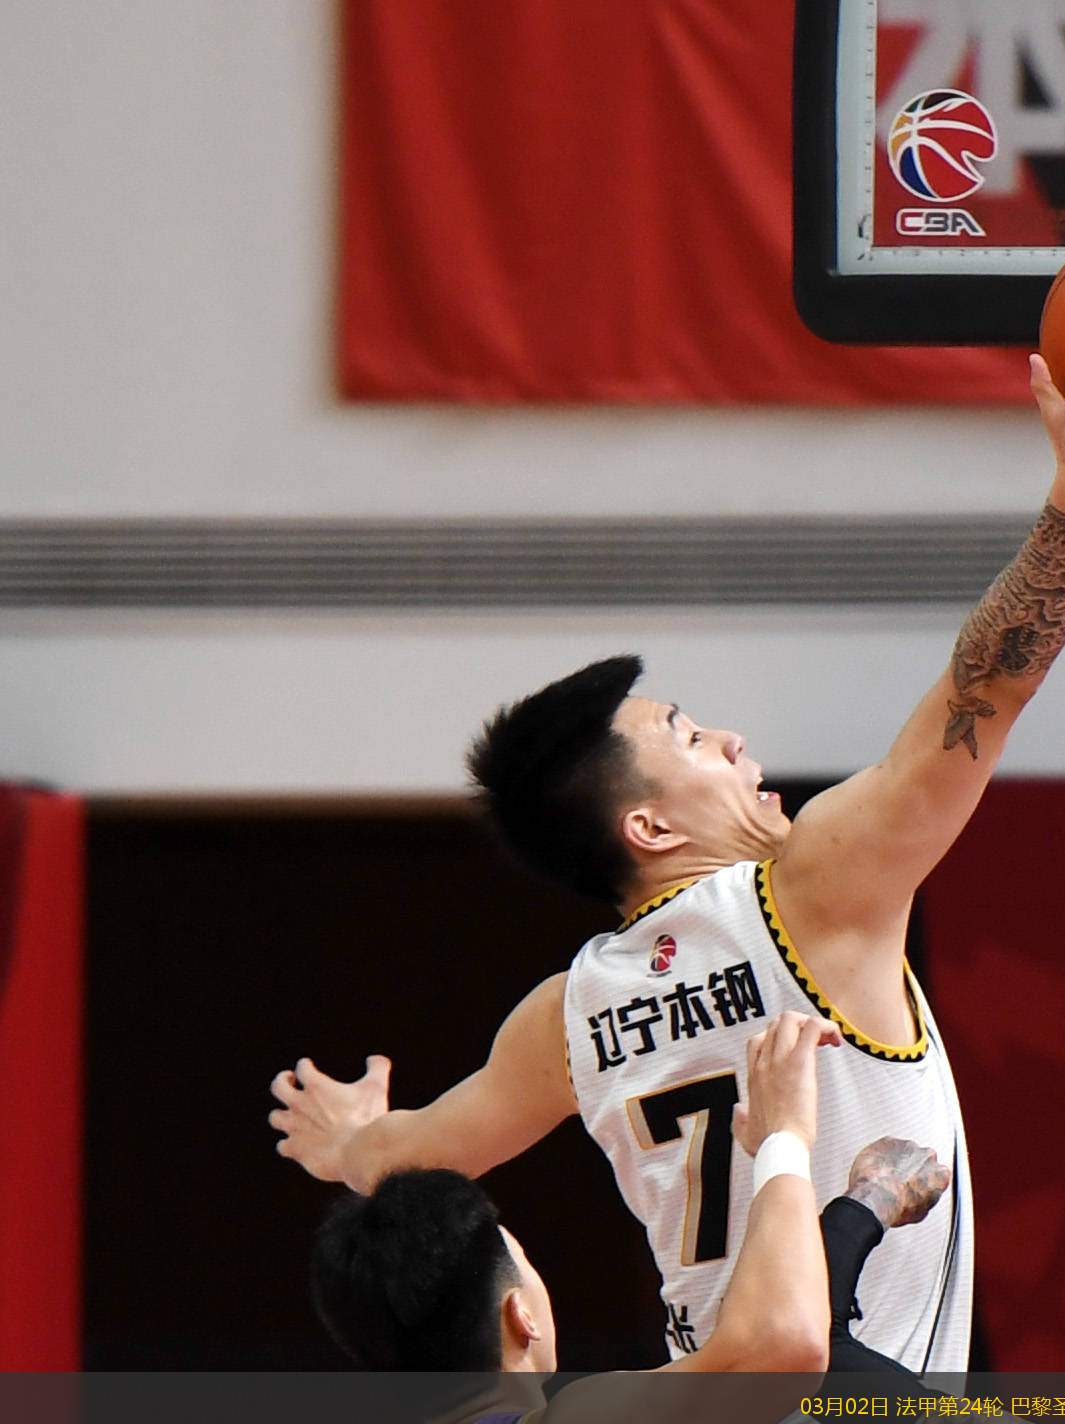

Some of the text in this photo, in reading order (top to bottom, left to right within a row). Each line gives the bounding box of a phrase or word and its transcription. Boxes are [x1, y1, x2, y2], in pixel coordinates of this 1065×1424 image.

[896, 208, 987, 237] CBA
[587, 960, 767, 1073] 辽宁本钢
[625, 1070, 740, 1267] 7
